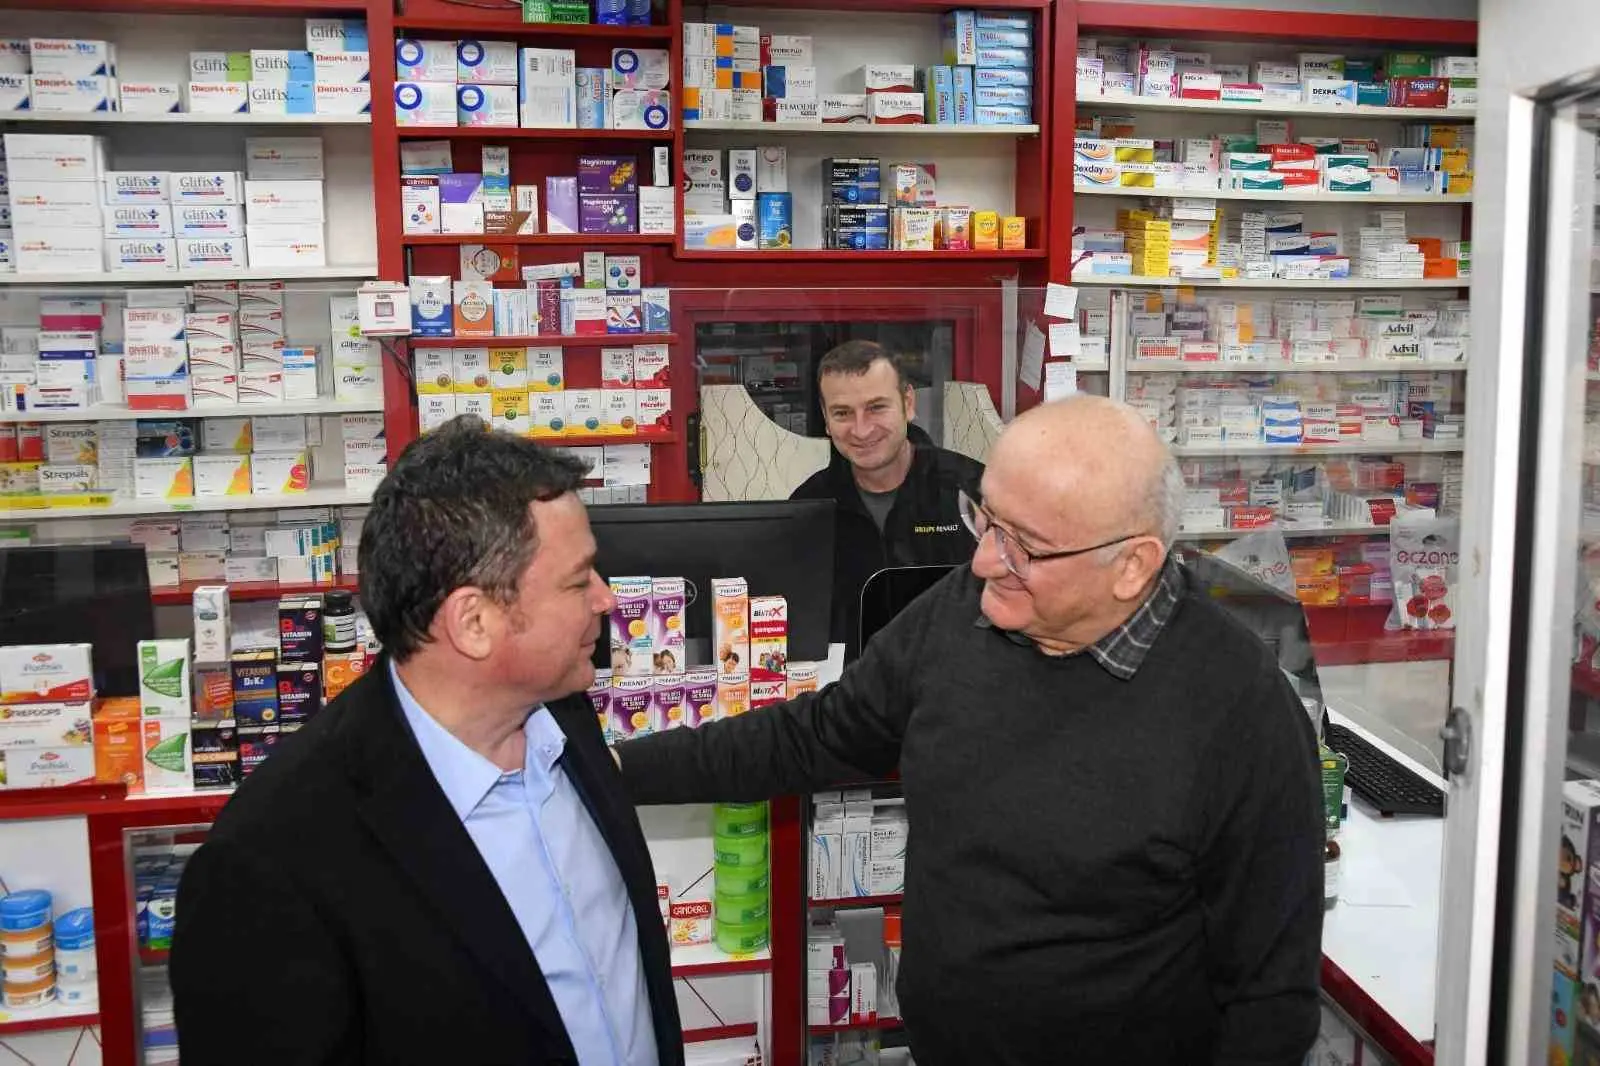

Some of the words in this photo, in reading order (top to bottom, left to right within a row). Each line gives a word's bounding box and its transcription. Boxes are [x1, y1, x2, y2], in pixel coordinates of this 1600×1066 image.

[1386, 323, 1414, 333] Advil
[1390, 343, 1419, 353] Advil
[42, 470, 89, 480] Strepsils
[672, 905, 709, 915] CANDEREL
